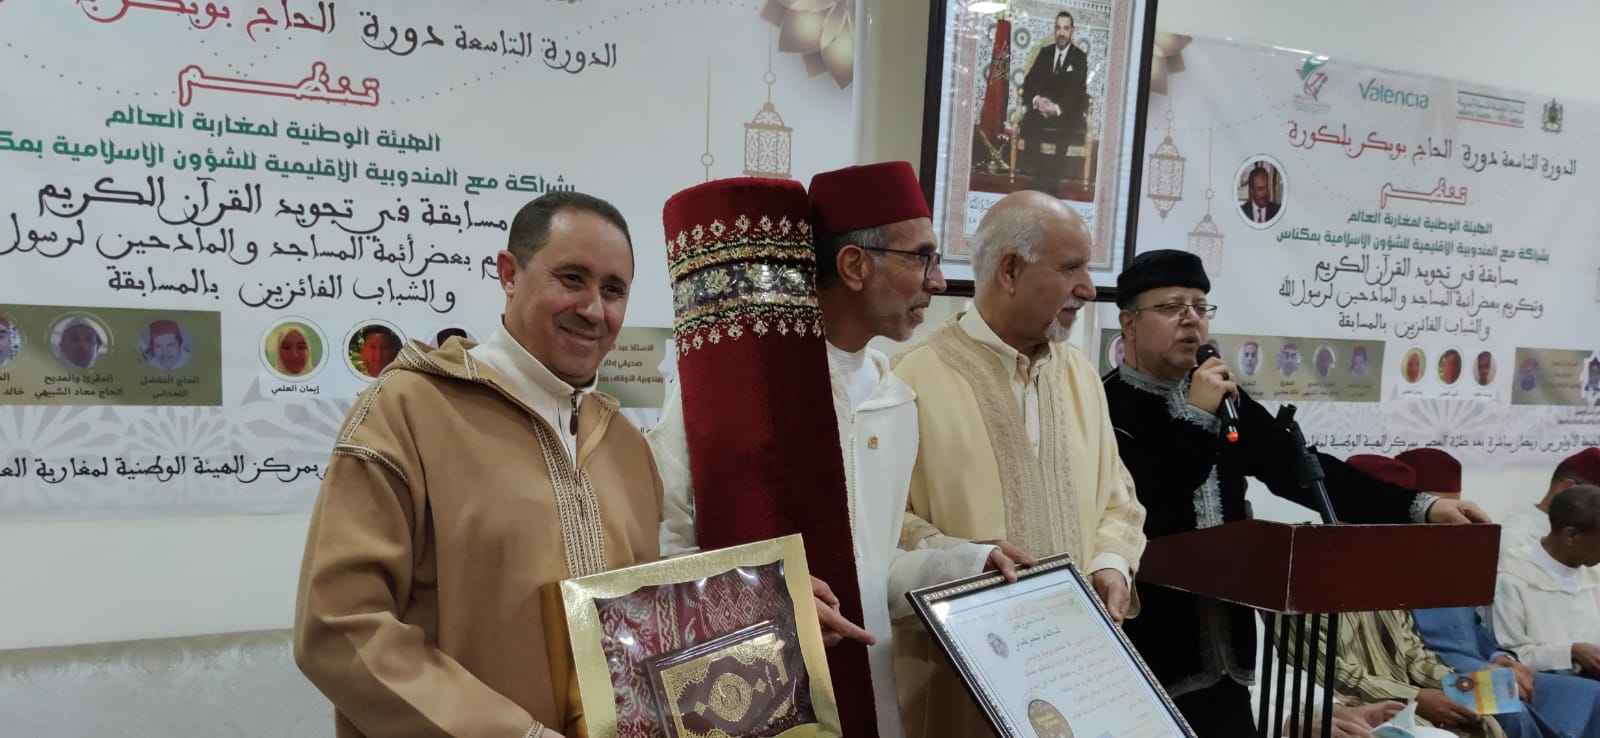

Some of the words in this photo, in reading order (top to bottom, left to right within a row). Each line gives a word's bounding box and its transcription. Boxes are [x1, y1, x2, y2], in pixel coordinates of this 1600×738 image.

[246, 0, 336, 42] الحاج
[360, 11, 444, 56] دورة
[455, 25, 532, 57] التاسعة
[541, 38, 617, 74] الدورة
[1358, 78, 1429, 110] Valencia
[104, 103, 184, 130] العالم
[192, 110, 278, 139] لمغاربة
[286, 121, 369, 149] الوطنية
[376, 126, 441, 154] الهيئة
[173, 146, 257, 172] للشؤون
[365, 161, 458, 188] المندوبية
[464, 174, 498, 195] مع
[38, 176, 165, 218] الكريم
[157, 176, 261, 226] القرآن
[421, 197, 508, 233] مسابقة
[1347, 208, 1381, 224] العالم
[0, 212, 84, 258] لرسول
[269, 234, 363, 262] المساجد
[1276, 227, 1321, 245] بمكناس
[400, 244, 471, 277] بعض
[1315, 254, 1369, 282] الكريم
[1364, 254, 1411, 286] القرآن
[107, 265, 219, 300] بالمسابقة
[239, 274, 342, 309] الفائزين
[353, 278, 455, 313] والشباب
[1279, 275, 1295, 297] الله
[1338, 312, 1387, 333] بالمسابقة
[35, 456, 108, 484] لمغاربة
[116, 455, 186, 482] الوطنية
[193, 454, 245, 479] الهيئة
[236, 457, 319, 483] بمركز
